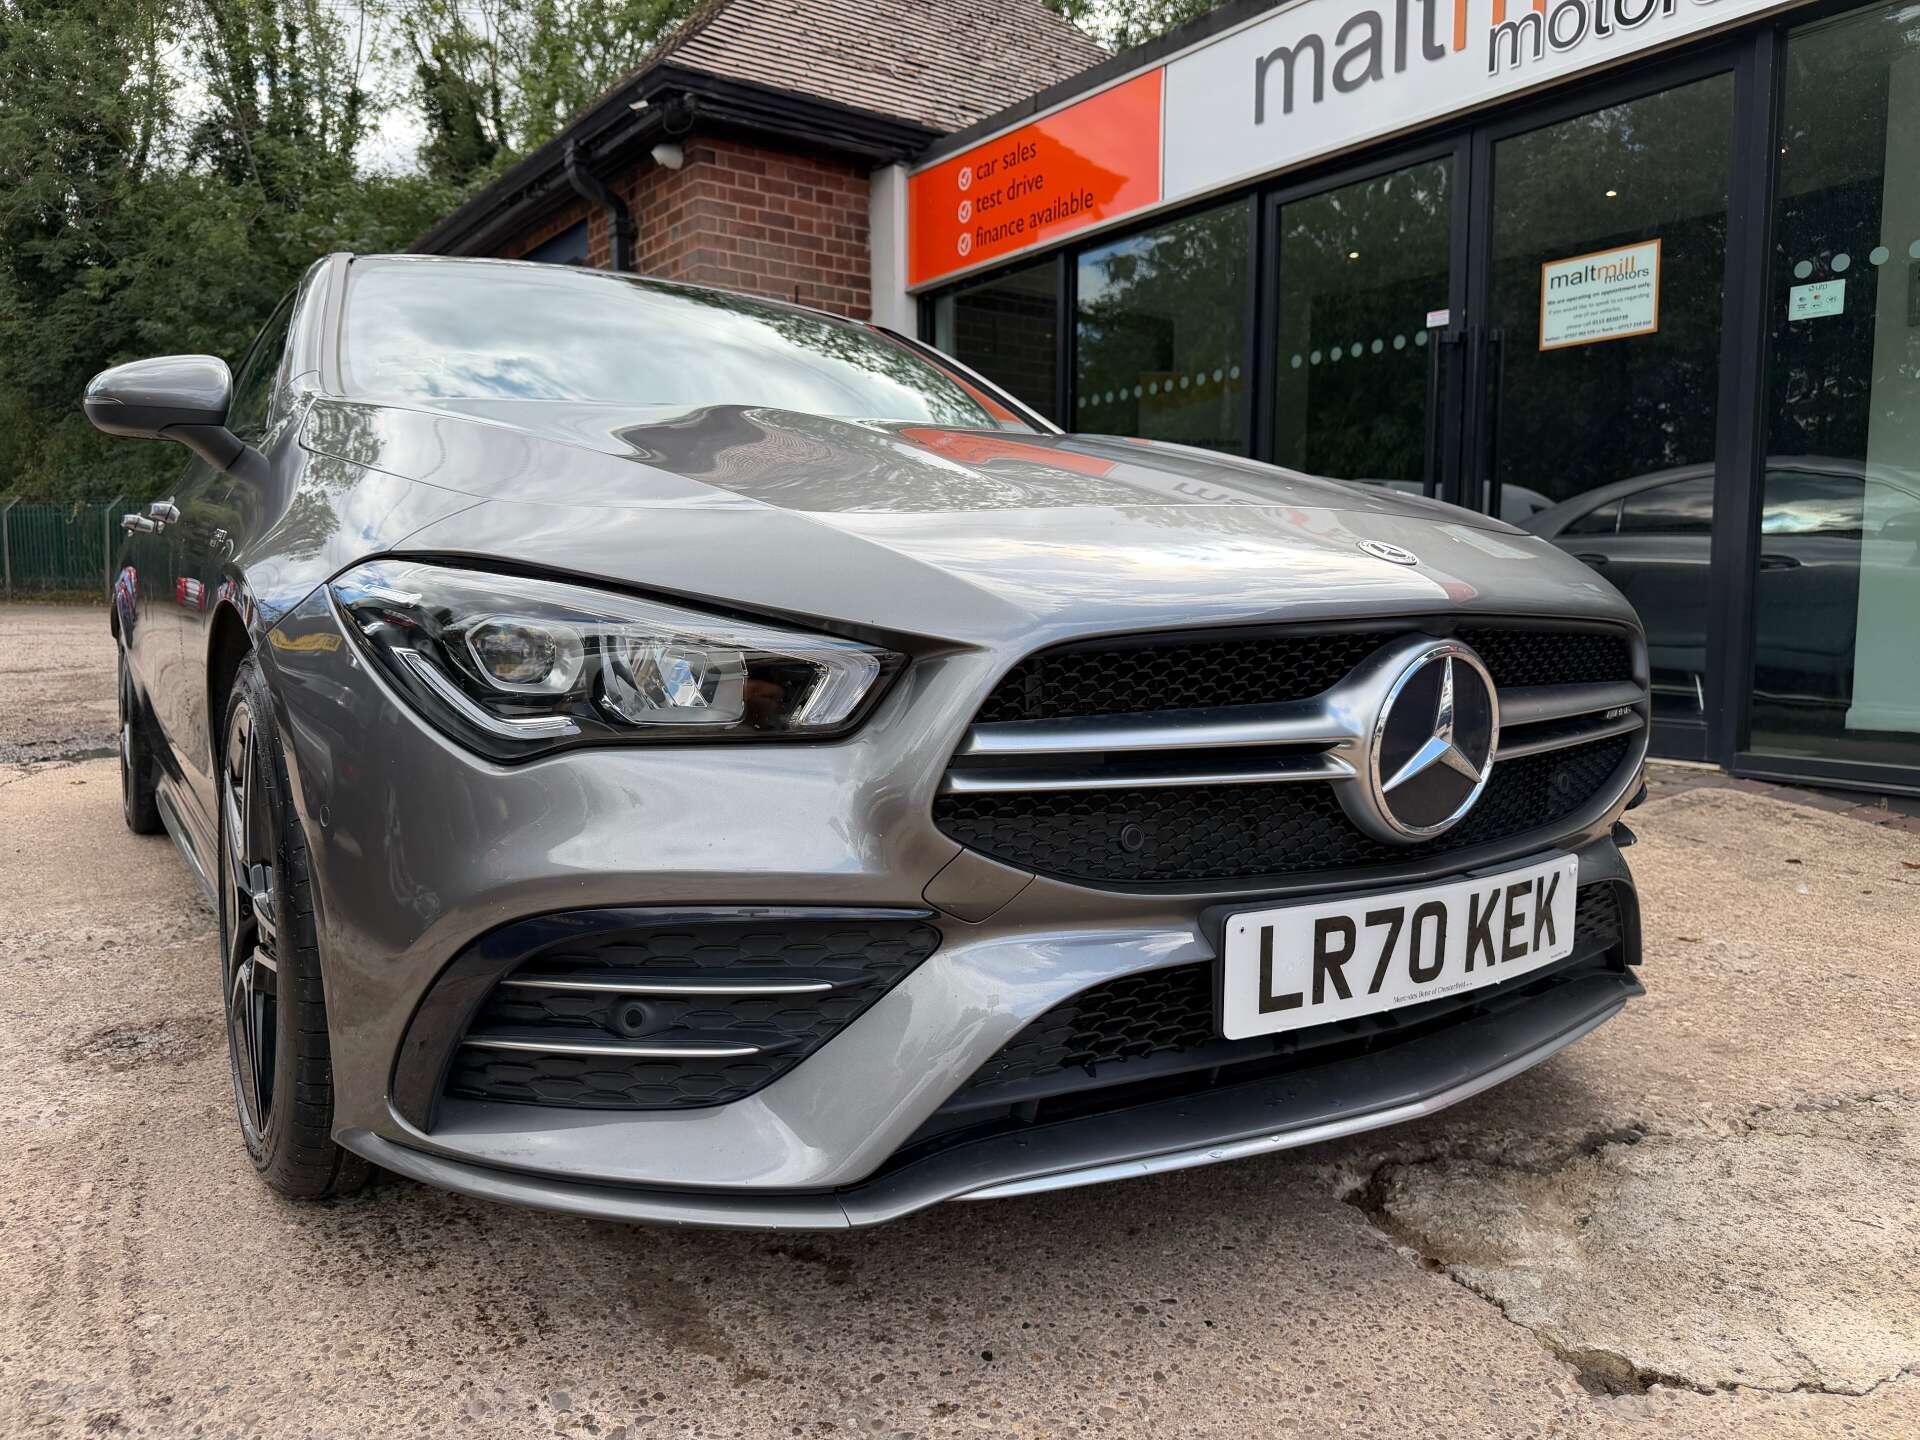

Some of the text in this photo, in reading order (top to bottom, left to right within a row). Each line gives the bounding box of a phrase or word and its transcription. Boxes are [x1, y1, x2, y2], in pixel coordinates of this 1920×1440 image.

[976, 140, 1037, 180] car sales
[976, 172, 1044, 213] test drive
[975, 188, 1094, 247] finance available
[1604, 267, 1649, 284] motors
[1258, 871, 1561, 1014] LR70 KEK
